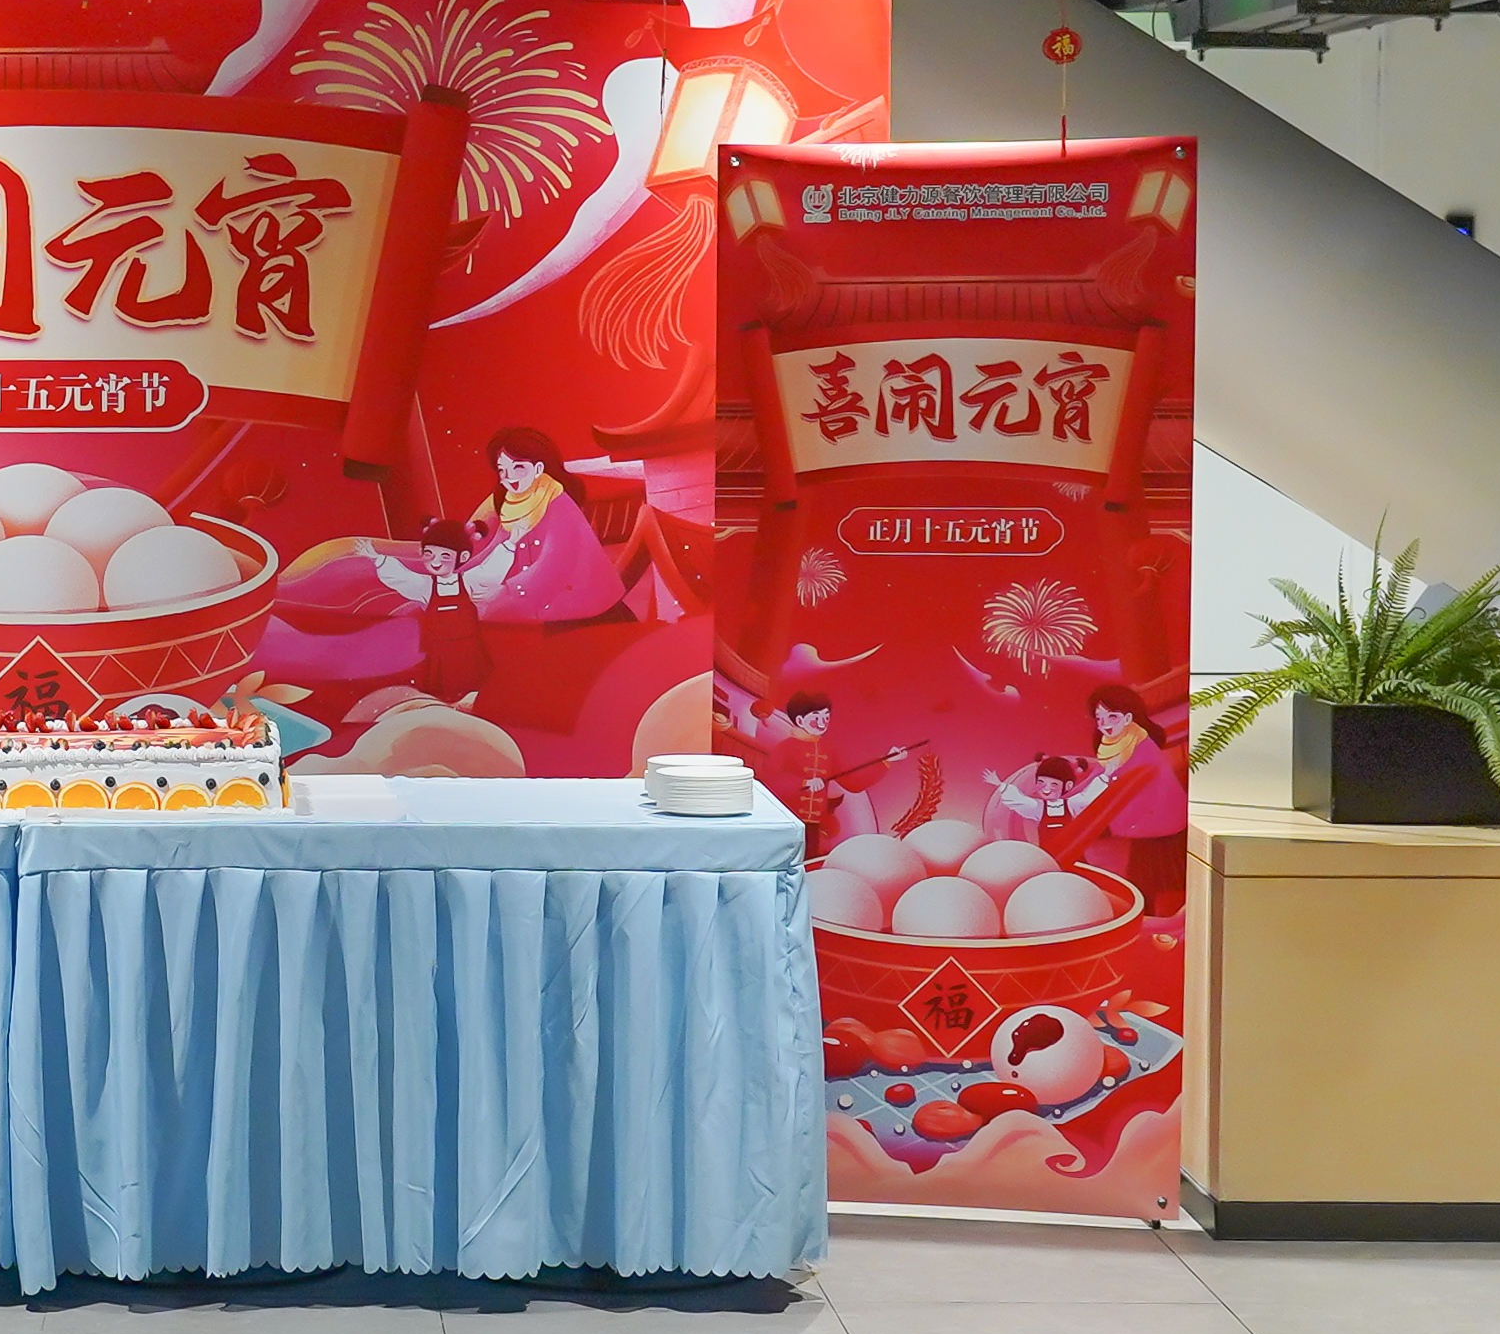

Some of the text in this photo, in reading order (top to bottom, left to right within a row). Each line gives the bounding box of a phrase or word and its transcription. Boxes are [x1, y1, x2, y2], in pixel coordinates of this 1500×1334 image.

[838, 183, 1108, 205] 北京健力源餐饮管理有限公司
[839, 208, 882, 222] Beijing
[885, 208, 911, 220] JLY
[801, 352, 1110, 445] 喜闹元宵
[869, 517, 1039, 545] 正月十五元宵节
[922, 982, 974, 1031] 福
